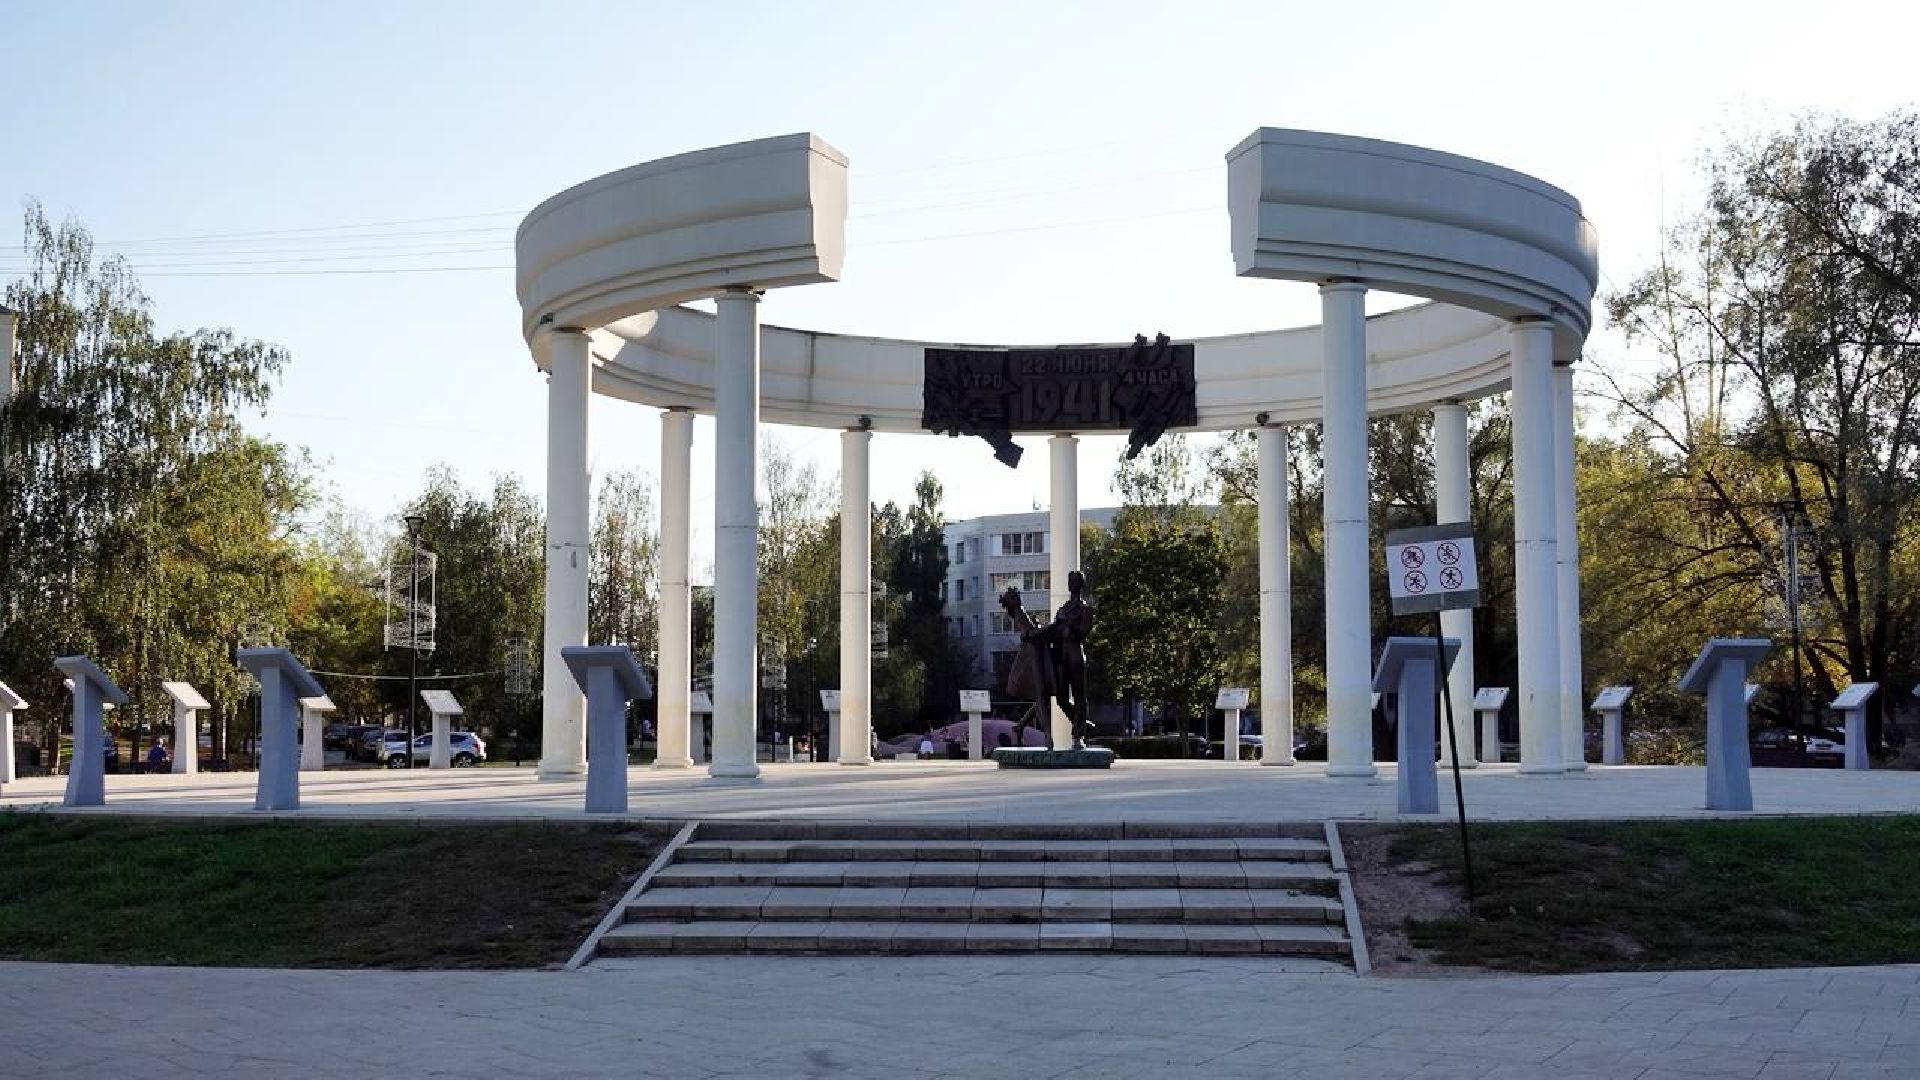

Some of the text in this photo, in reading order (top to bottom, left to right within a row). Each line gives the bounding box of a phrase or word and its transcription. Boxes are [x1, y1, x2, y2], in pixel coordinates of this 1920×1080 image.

[1022, 356, 1047, 373] 22
[961, 374, 1002, 388] УТРО
[1123, 369, 1134, 385] 4
[1021, 379, 1110, 421] 1941
